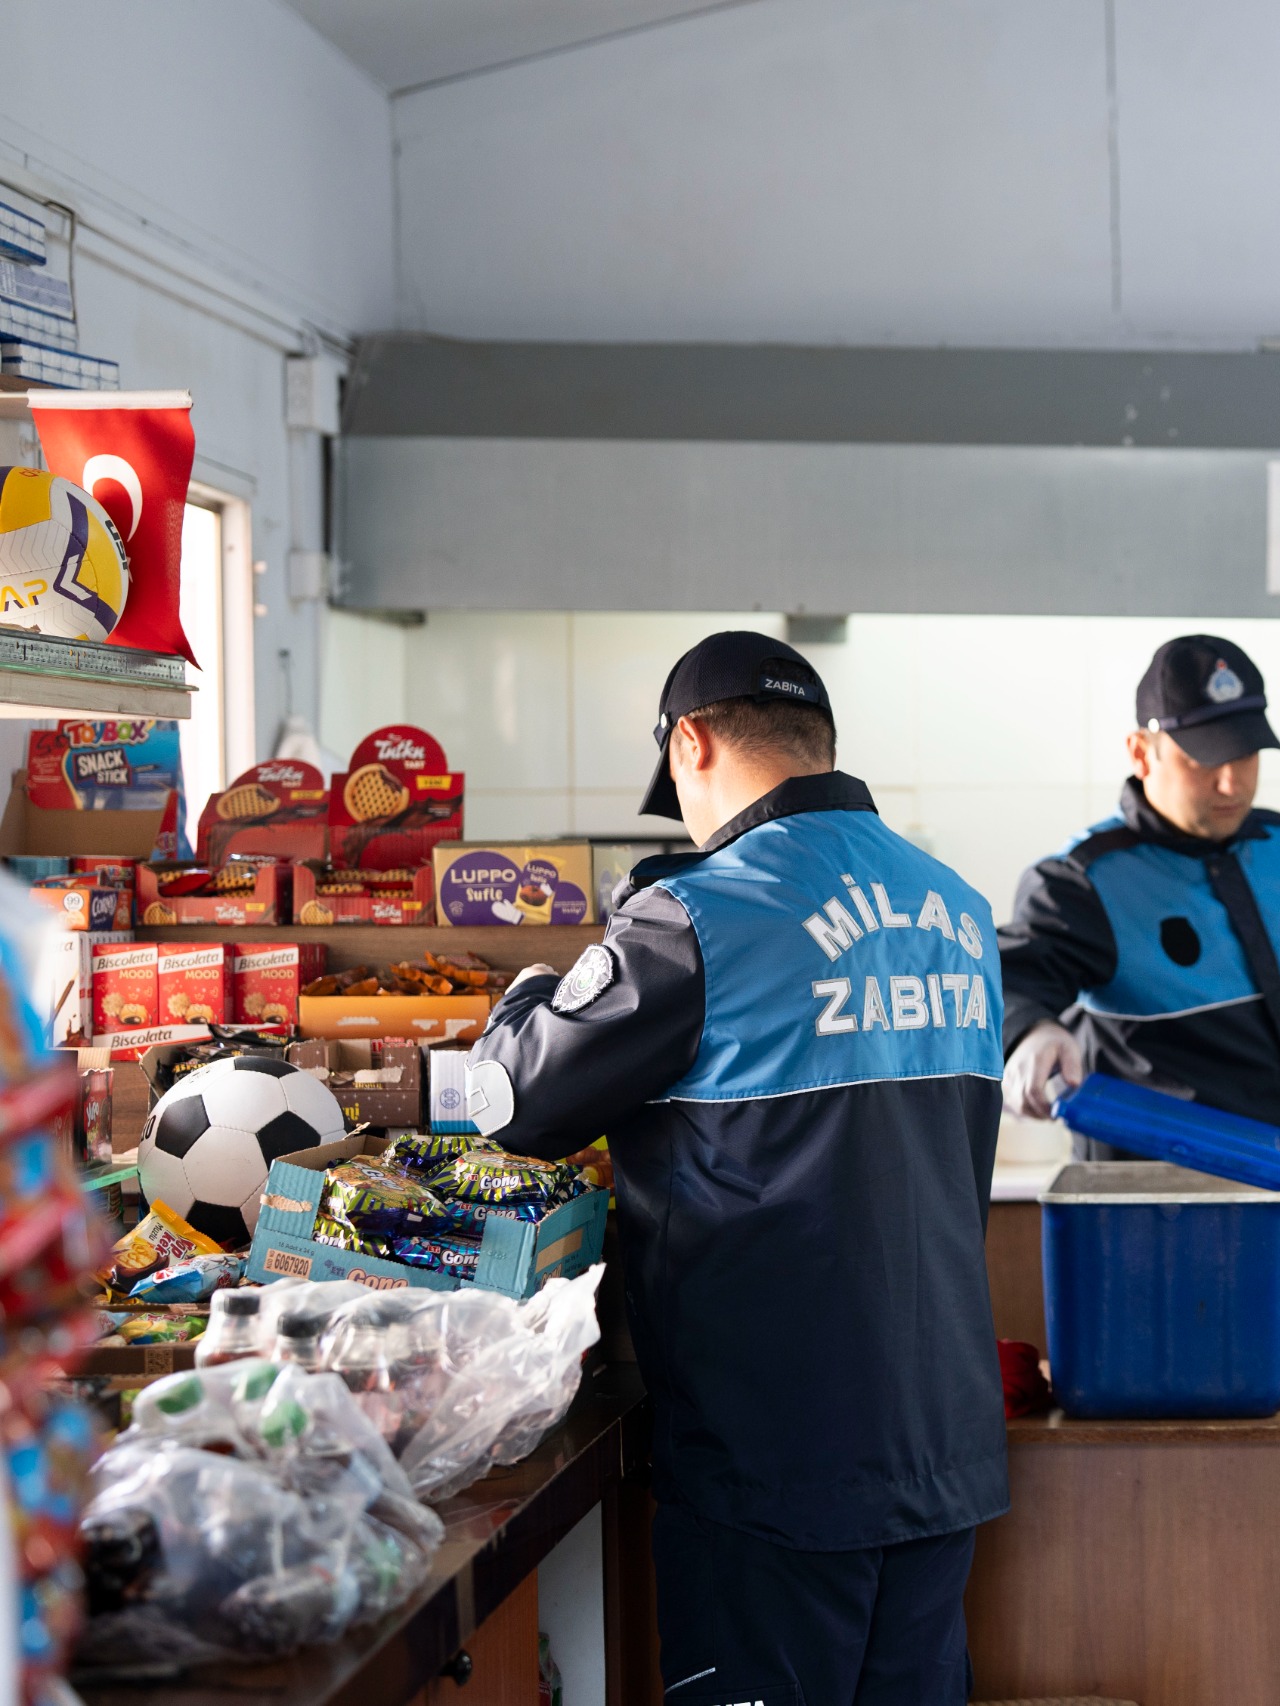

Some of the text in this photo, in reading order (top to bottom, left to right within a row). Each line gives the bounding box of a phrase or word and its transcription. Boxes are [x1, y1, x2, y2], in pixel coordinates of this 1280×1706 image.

[764, 678, 805, 696] ZABITA
[65, 720, 148, 746] TOYBOX
[77, 749, 124, 777] SNACK
[97, 768, 128, 784] STICK
[451, 868, 516, 884] LUPPO
[466, 887, 503, 902] Sufle
[802, 873, 984, 963] MİLAS
[97, 951, 154, 970] Biscolata
[163, 951, 219, 970] Biscolata
[239, 951, 295, 970] Biscolata
[119, 969, 154, 980] MOOD
[185, 969, 220, 980] MOOD
[261, 969, 295, 980] MOOD
[812, 974, 988, 1037] ZABITA
[111, 1029, 173, 1049] Biscolata
[480, 1174, 521, 1191] Gong
[274, 1253, 310, 1277] 6067920
